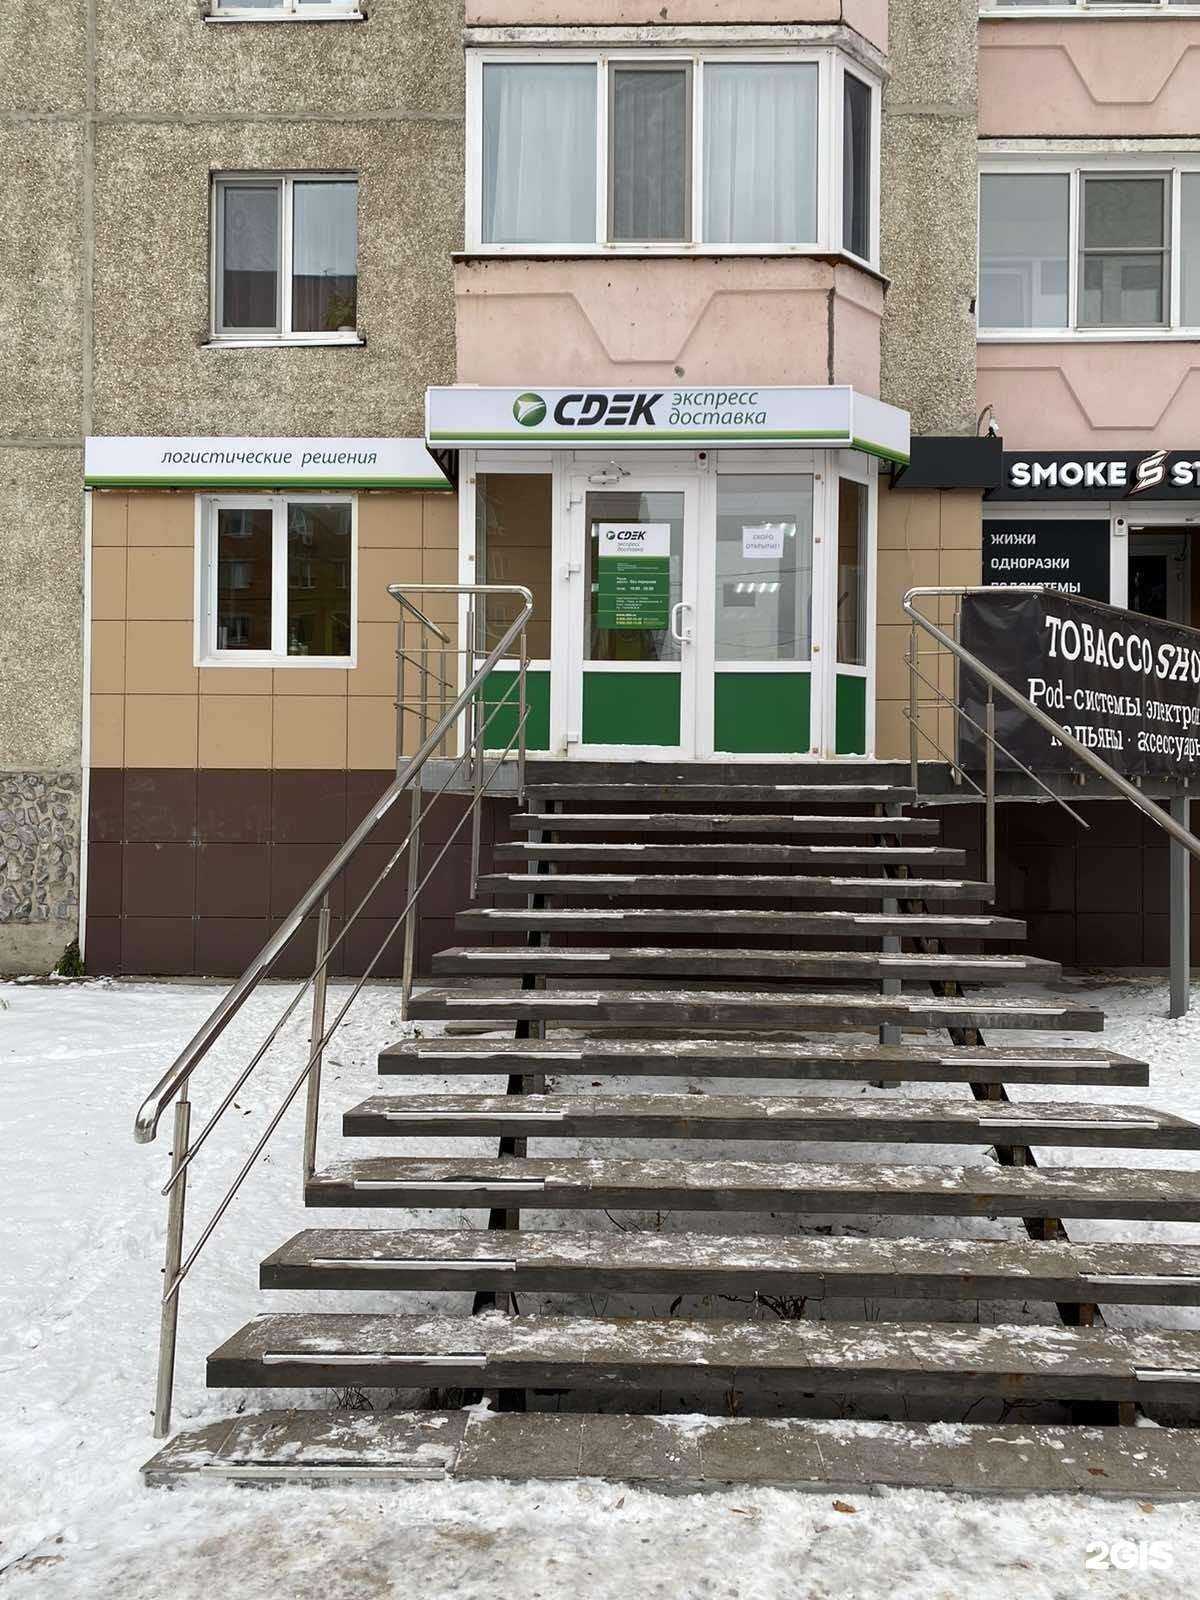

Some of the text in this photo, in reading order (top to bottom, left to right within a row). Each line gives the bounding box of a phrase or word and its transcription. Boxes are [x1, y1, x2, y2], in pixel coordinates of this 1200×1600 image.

[671, 391, 759, 409] экспресс
[554, 393, 664, 426] CDEK
[668, 408, 768, 425] доставка
[160, 449, 378, 468] логистические решения
[1010, 461, 1128, 487] SMOKE
[617, 530, 646, 541] CDEK
[991, 533, 1037, 545] ЖИЖИ
[990, 557, 1070, 570] ОДНОРАЗКИ
[1045, 615, 1153, 675] TOBACCO
[1027, 678, 1143, 717] Pod-системы
